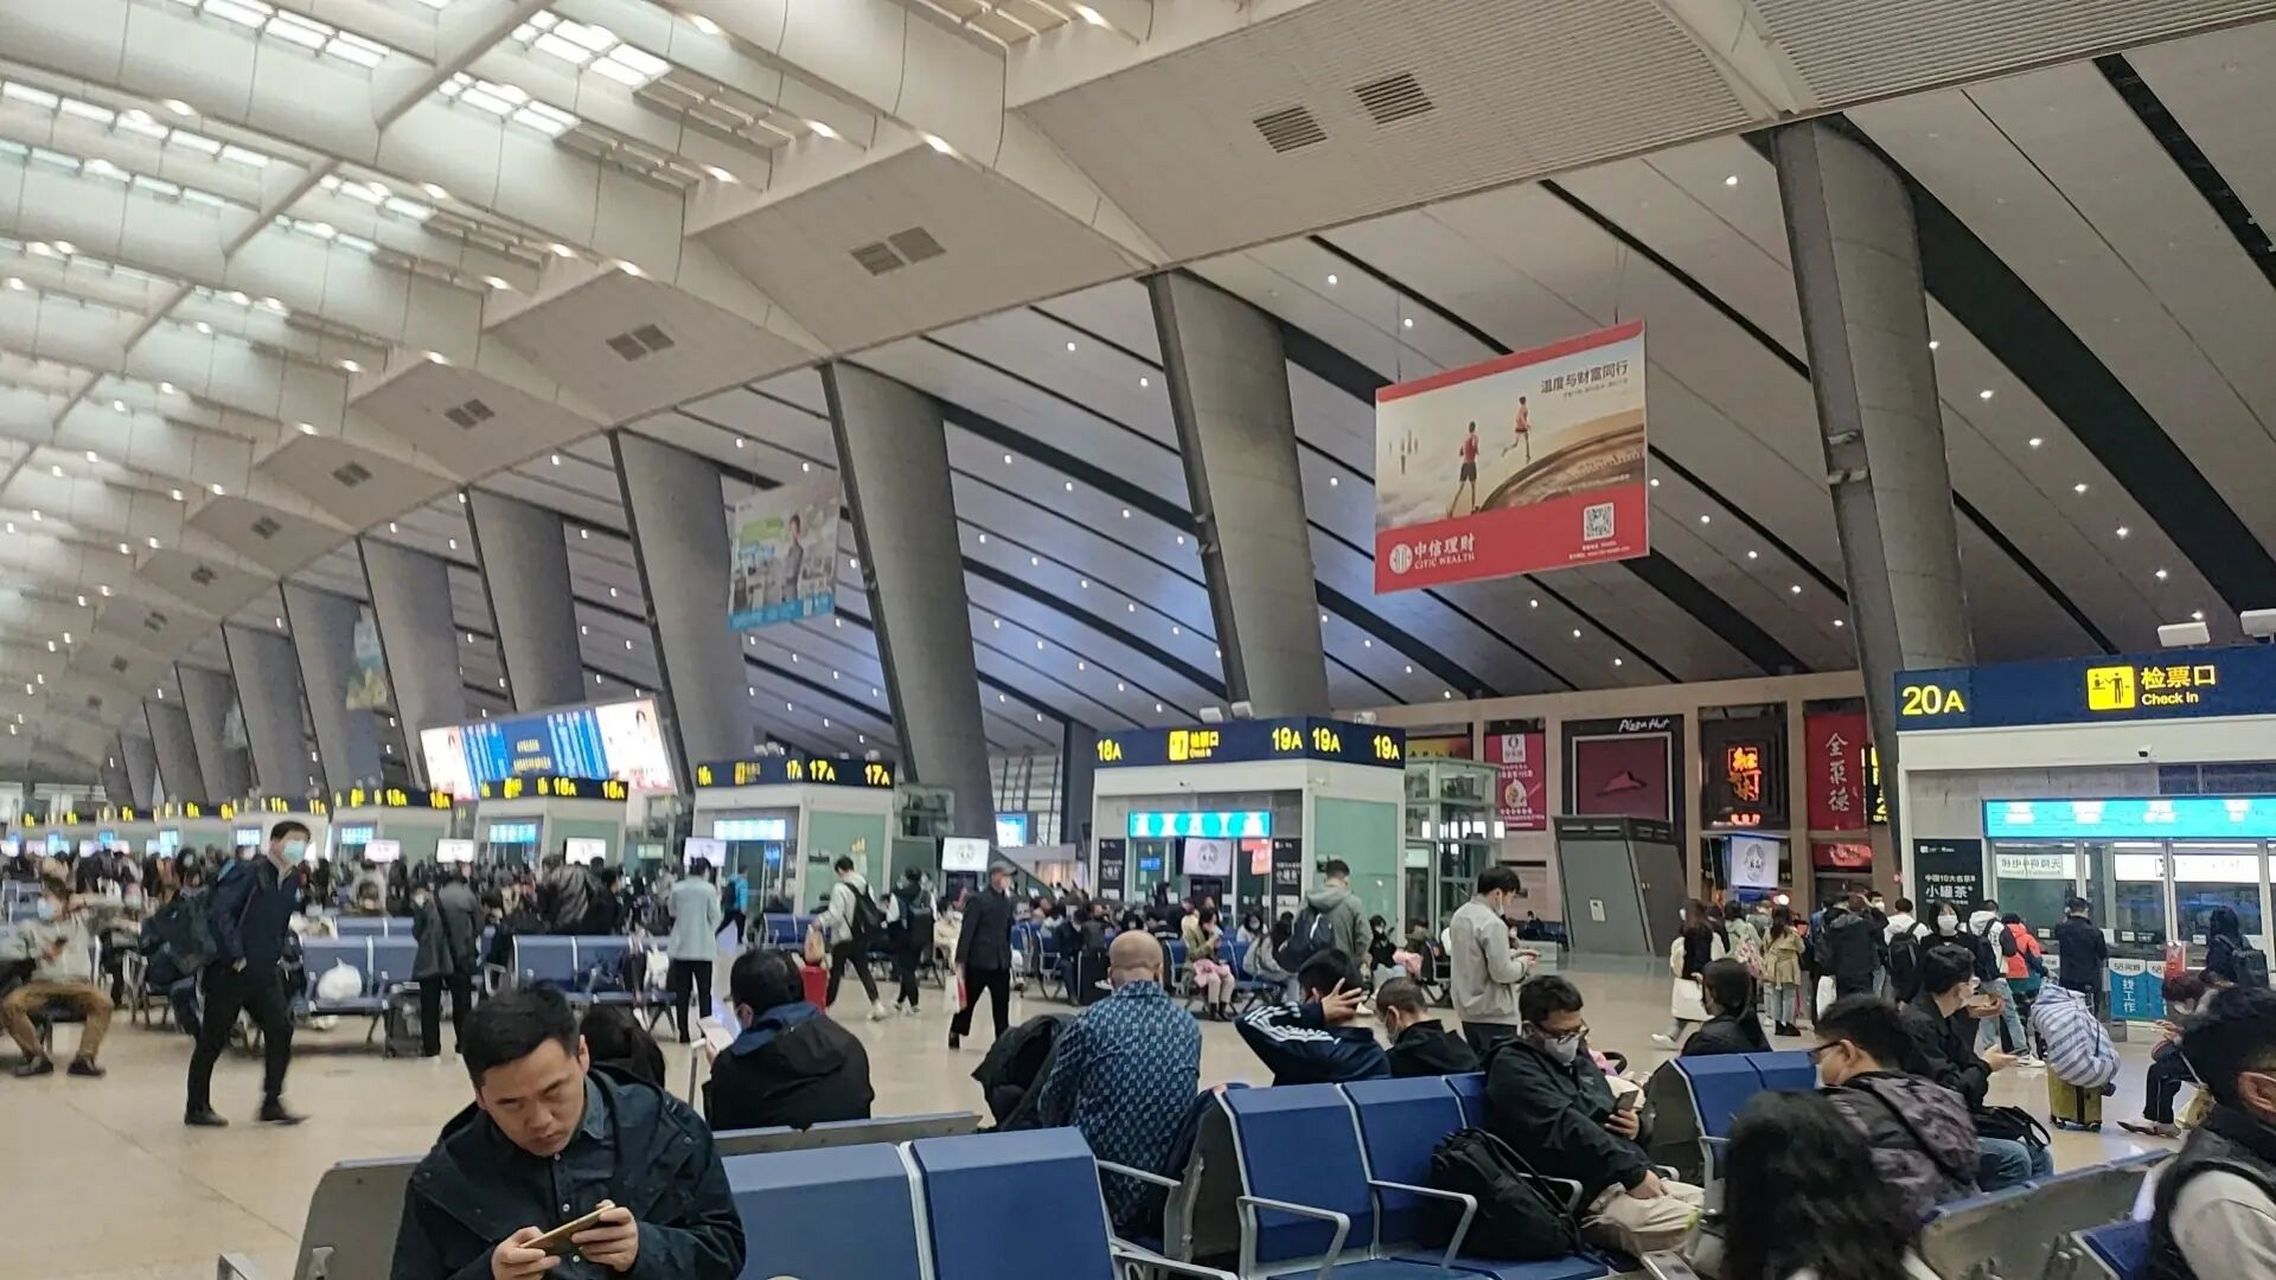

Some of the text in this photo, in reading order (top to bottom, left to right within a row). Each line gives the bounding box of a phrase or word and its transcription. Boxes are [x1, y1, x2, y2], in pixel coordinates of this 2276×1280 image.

[1541, 360, 1628, 393] 温度与财富同行
[2140, 664, 2216, 690] 检票口
[1902, 685, 1966, 716] 20A
[2141, 691, 2199, 706] Check In
[1618, 717, 1671, 733] Pizza Hut
[1097, 739, 1122, 761] 18A
[1272, 726, 1302, 751] 19A
[1312, 727, 1341, 753] 19A
[1373, 734, 1400, 760] 19A
[809, 760, 836, 782] 17A
[865, 764, 890, 785] 17A
[1925, 885, 1967, 898] 小罐茶
